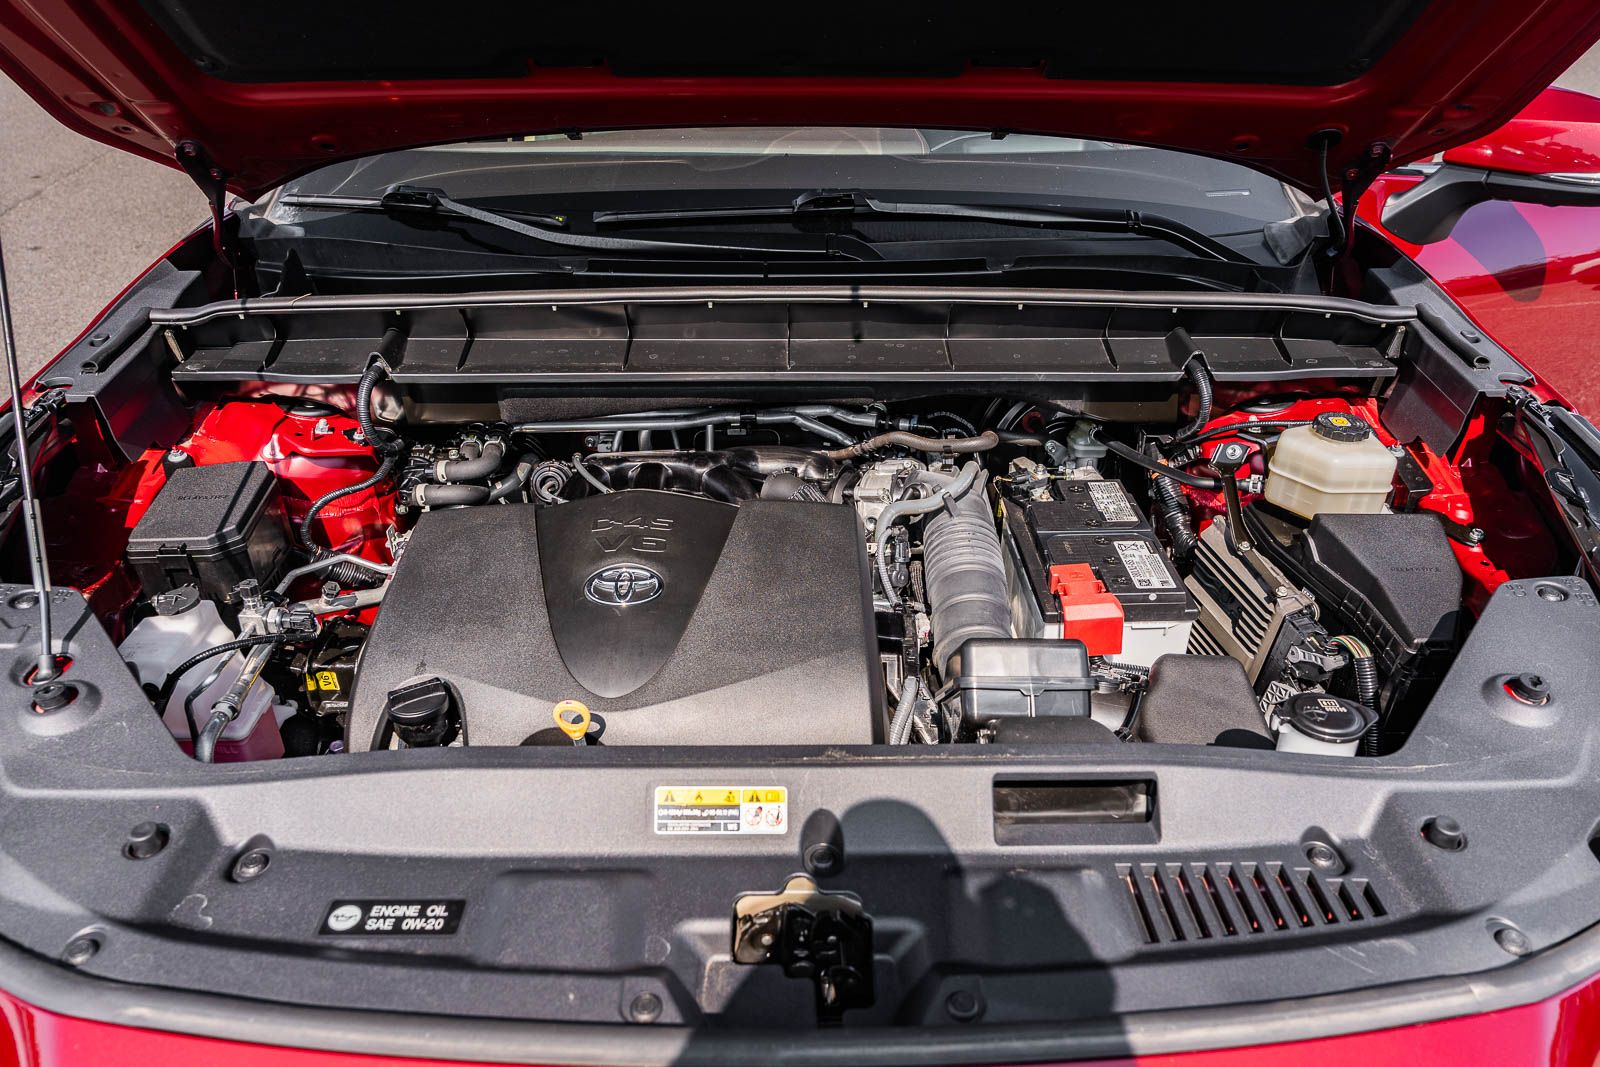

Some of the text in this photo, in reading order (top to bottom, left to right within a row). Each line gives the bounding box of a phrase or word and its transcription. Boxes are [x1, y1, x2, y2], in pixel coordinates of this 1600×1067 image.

[591, 517, 674, 532] D-4S
[594, 534, 667, 553] V6
[369, 905, 449, 917] ENGINE OIL
[364, 918, 445, 931] SAE 0W-20
